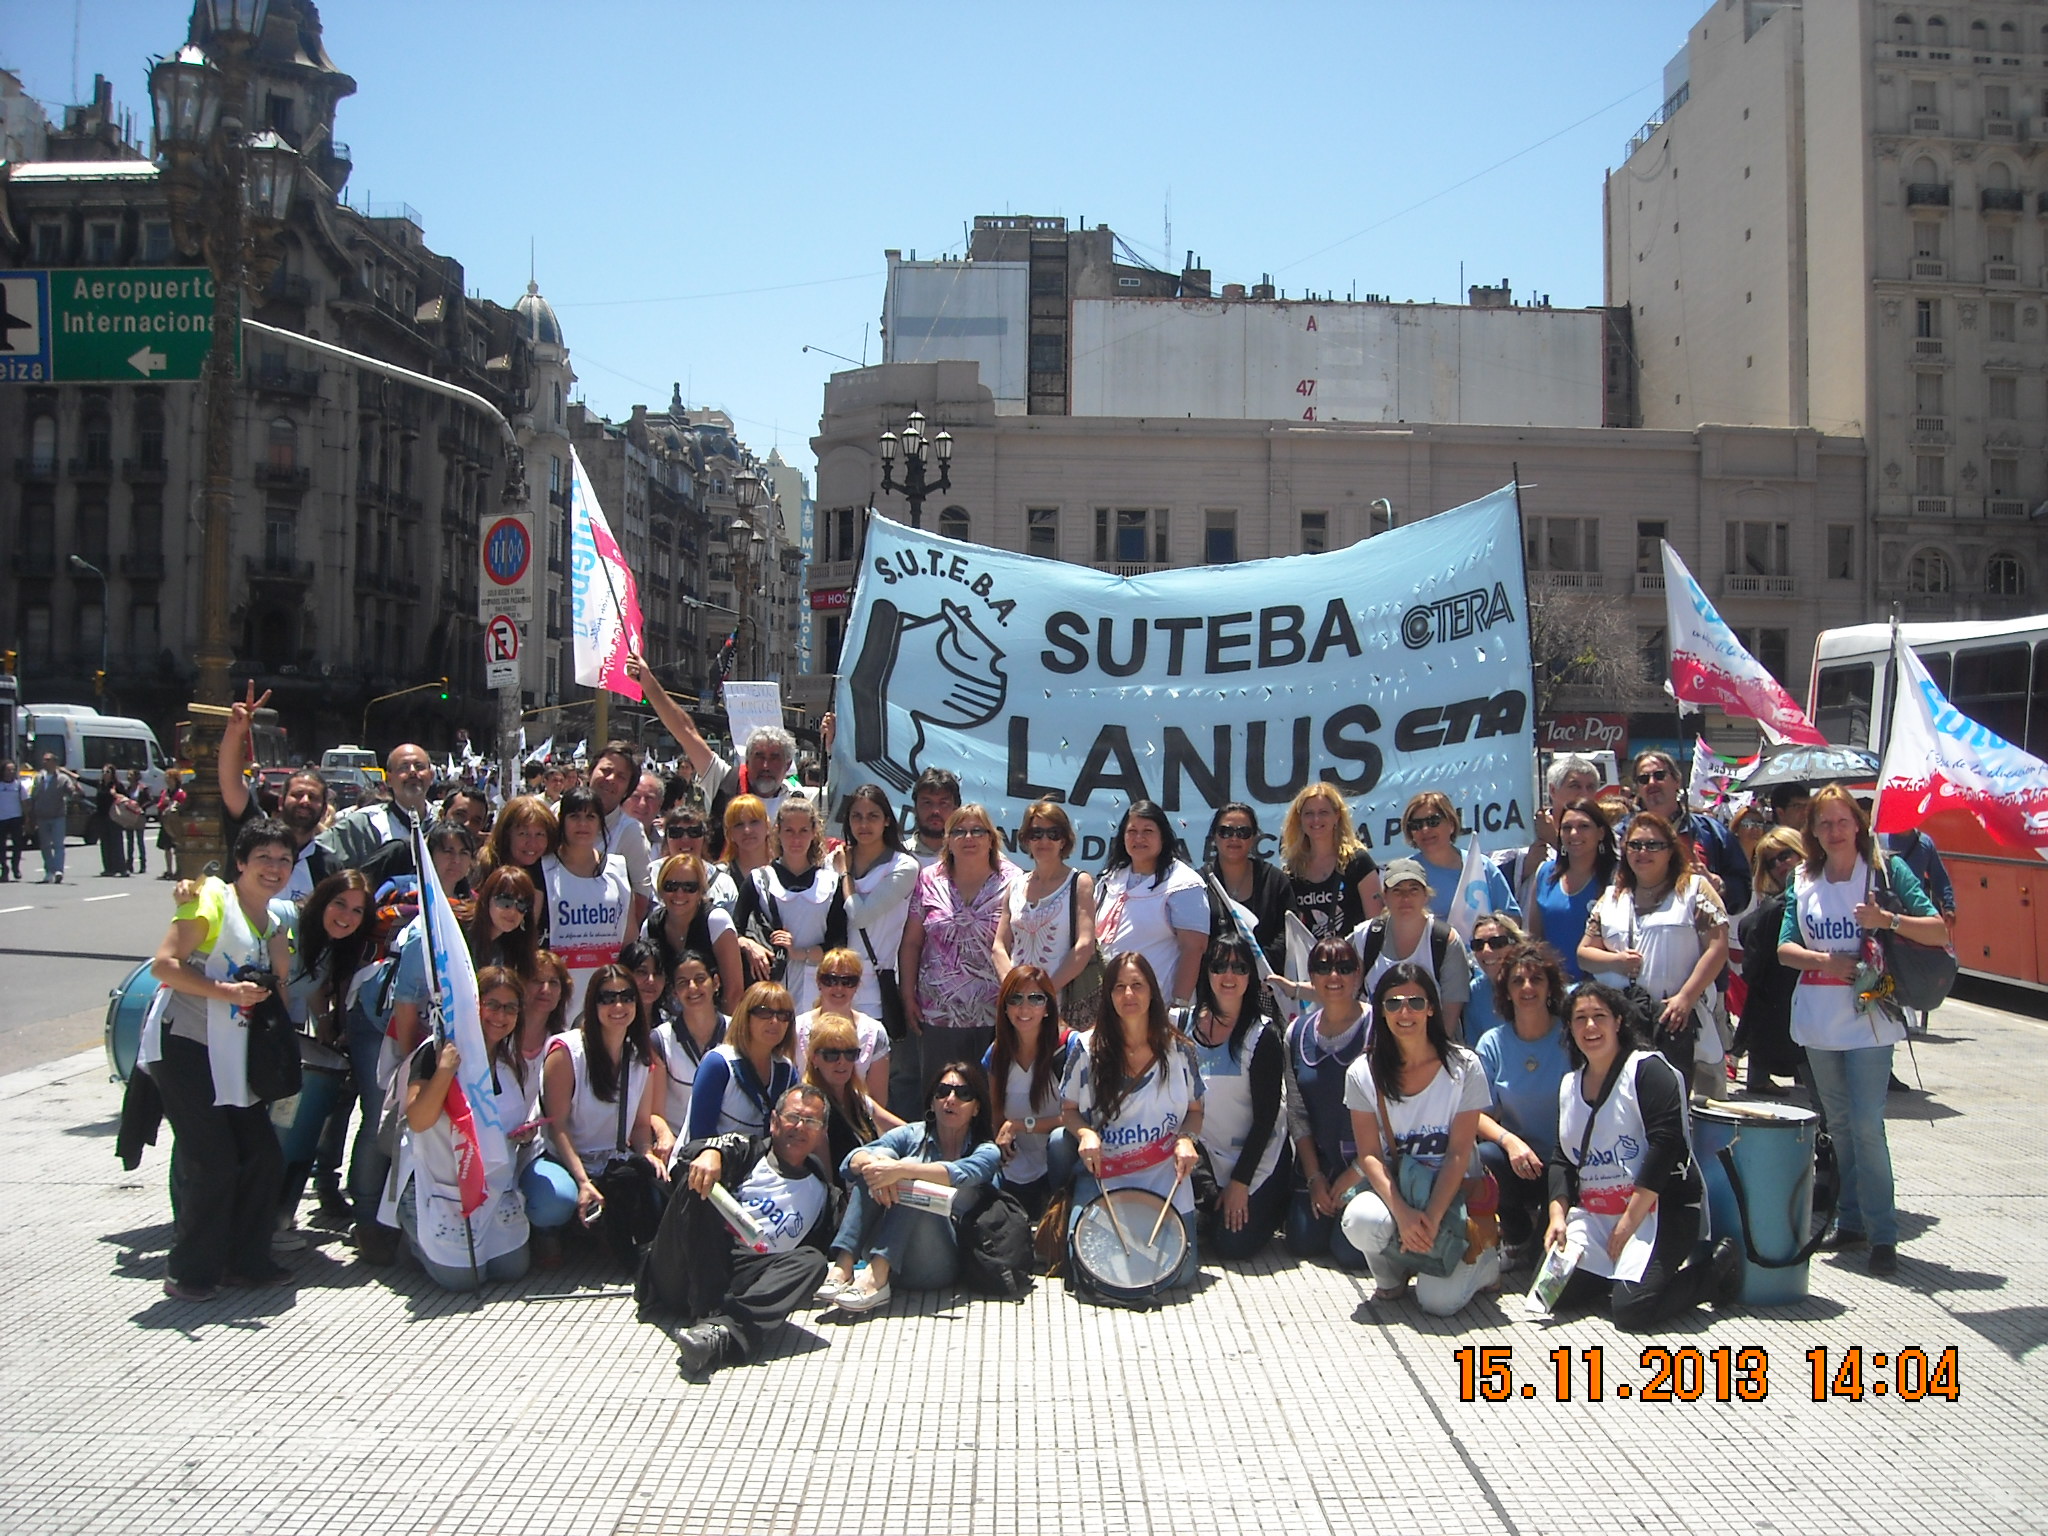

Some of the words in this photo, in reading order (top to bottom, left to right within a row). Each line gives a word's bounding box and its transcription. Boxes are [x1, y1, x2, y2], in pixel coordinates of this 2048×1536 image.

[73, 277, 216, 303] Aeropuerto
[63, 311, 215, 333] Internaciona
[1306, 315, 1317, 331] A
[1296, 380, 1316, 396] 47
[1401, 581, 1516, 650] CTERA
[800, 613, 812, 673] Hotel
[1040, 597, 1363, 678] SUTEBA
[1395, 689, 1527, 752] CTA
[1584, 717, 1624, 751] Pop
[1008, 703, 1383, 812] LANUS
[1384, 799, 1526, 846] PLICA
[558, 900, 616, 926] Suteba
